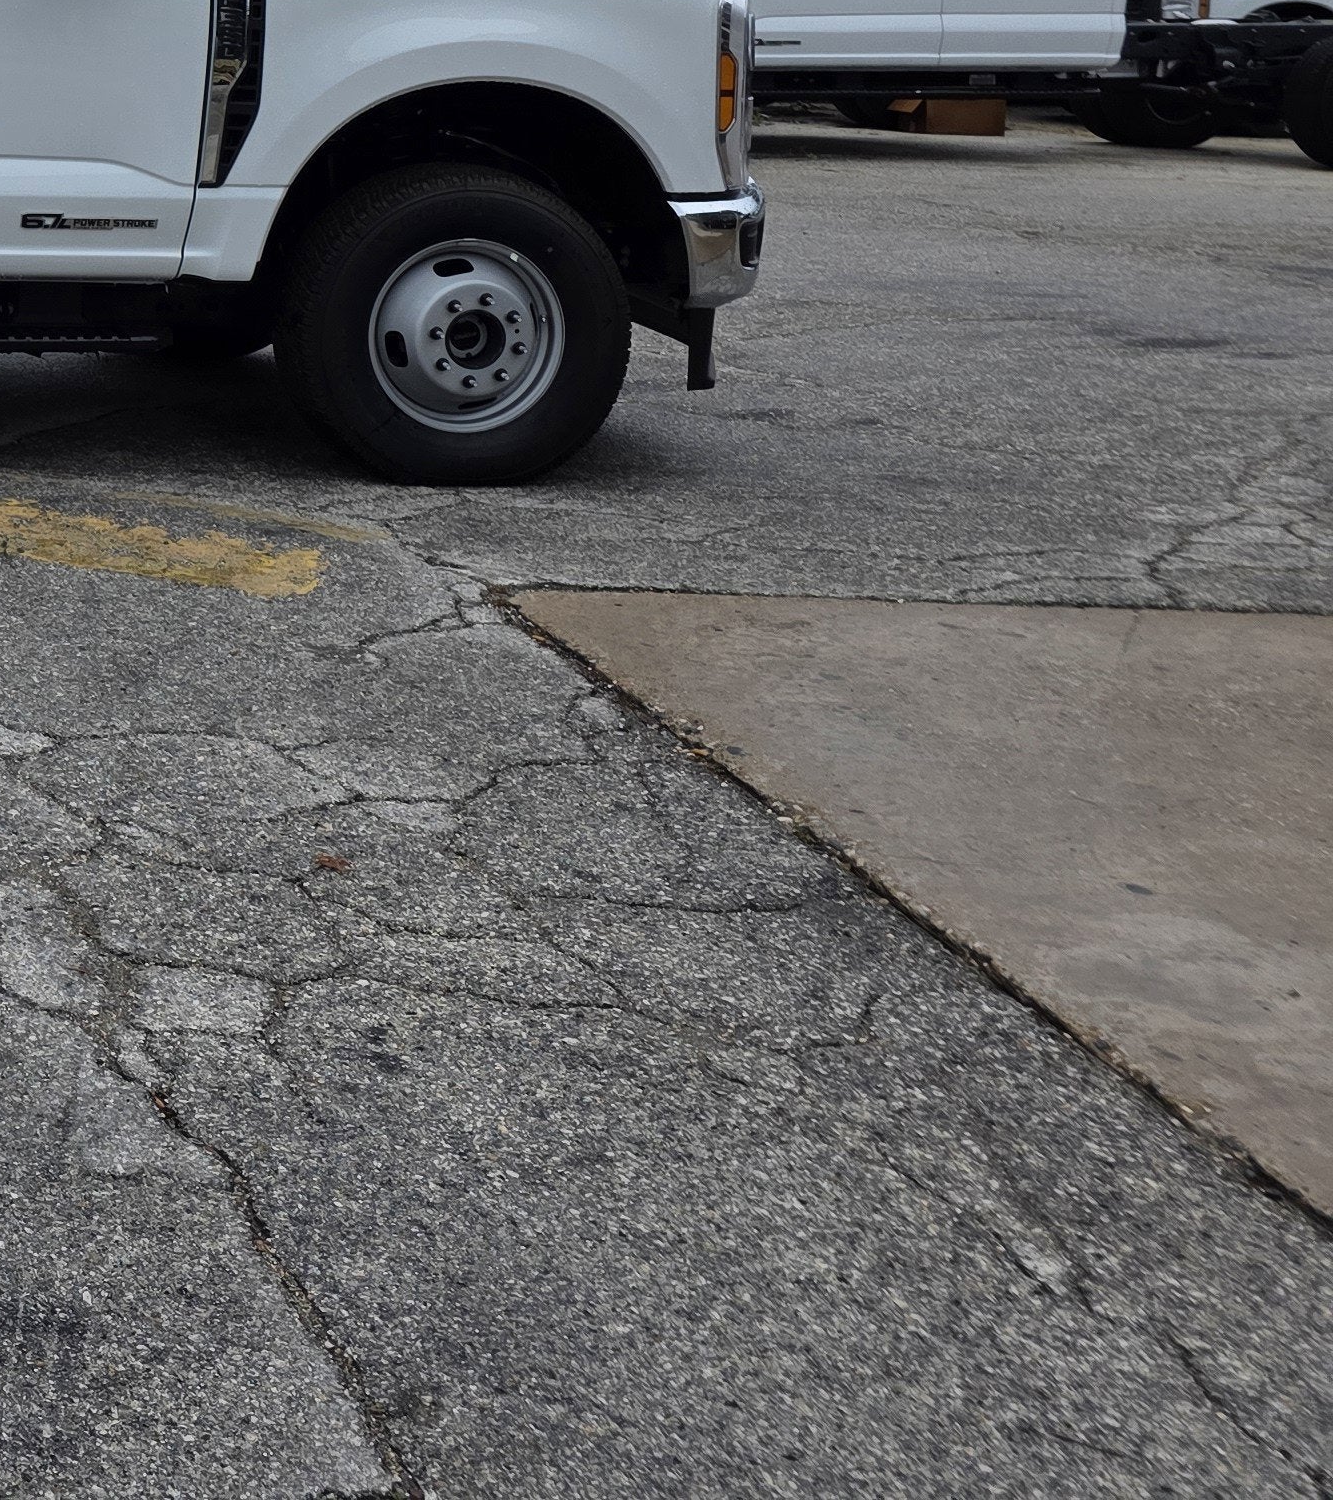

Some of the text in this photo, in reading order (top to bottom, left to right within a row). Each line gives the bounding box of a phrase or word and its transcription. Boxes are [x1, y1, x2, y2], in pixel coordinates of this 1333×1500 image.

[20, 213, 156, 229] 6.7L POWER STROKE
